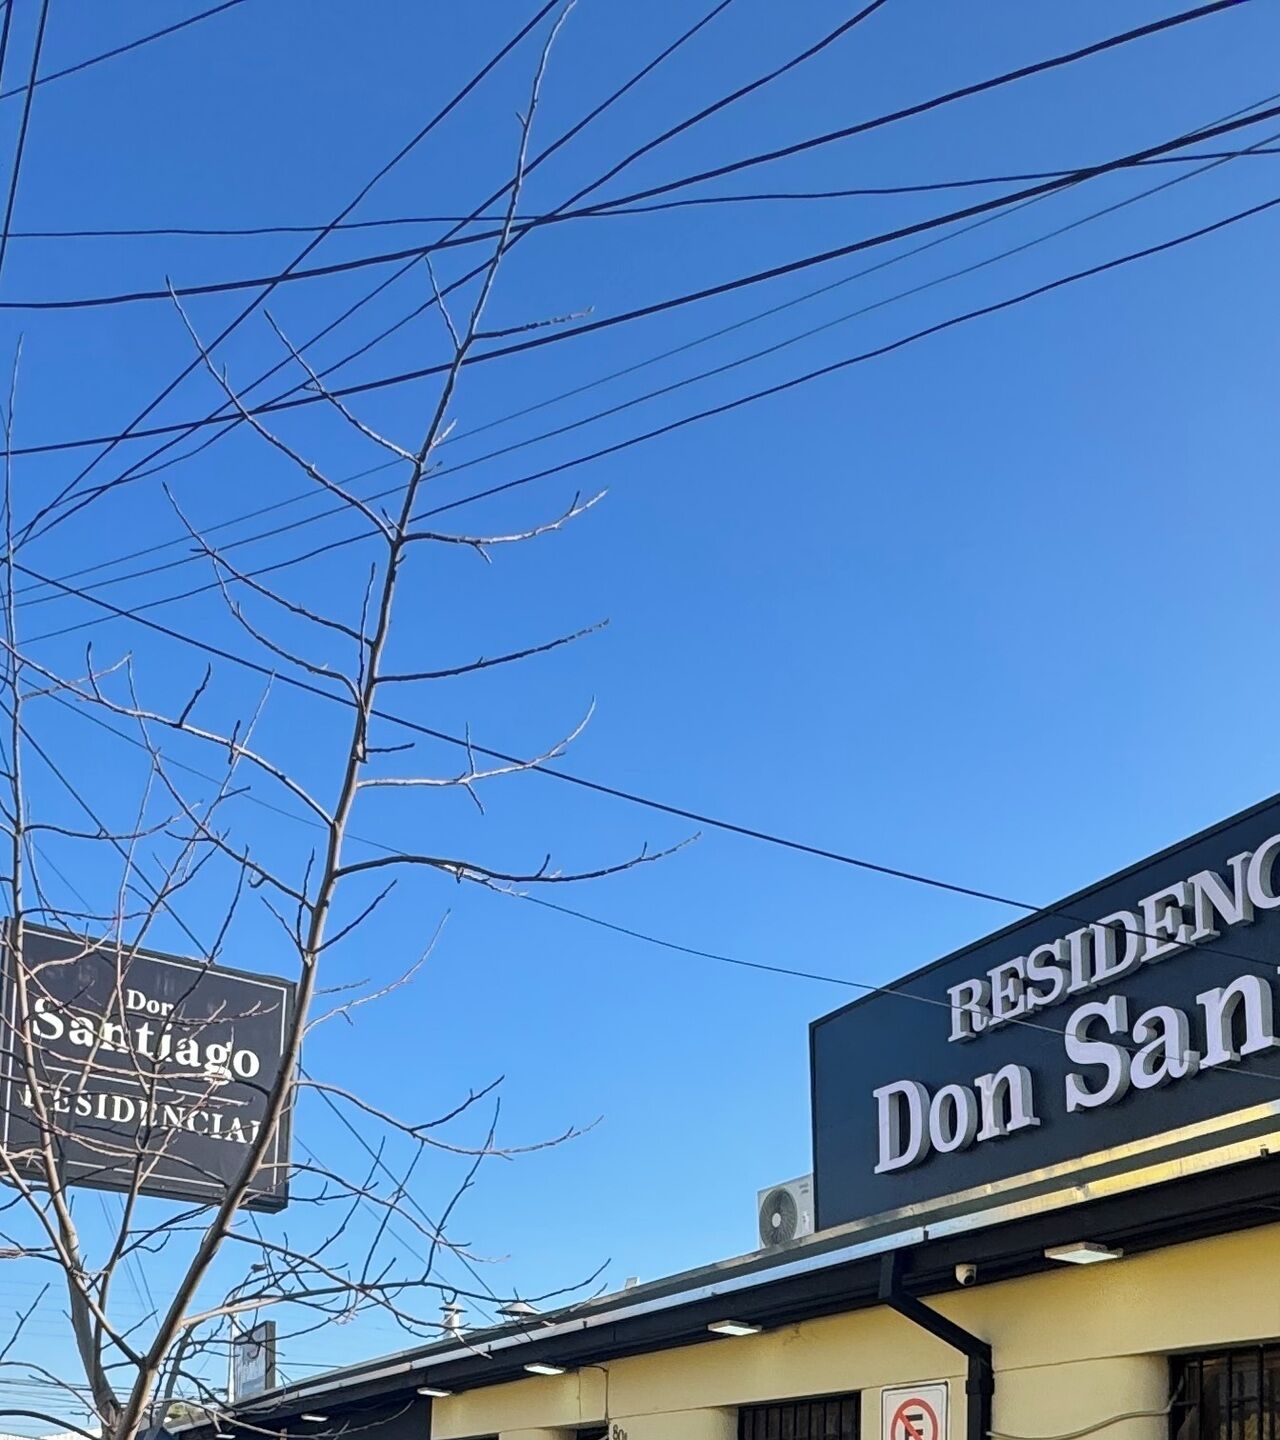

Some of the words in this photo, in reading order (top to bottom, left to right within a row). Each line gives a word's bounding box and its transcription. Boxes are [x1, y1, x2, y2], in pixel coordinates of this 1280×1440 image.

[32, 997, 260, 1086] Santiago
[126, 988, 175, 1016] Don
[873, 1063, 1041, 1174] Don
